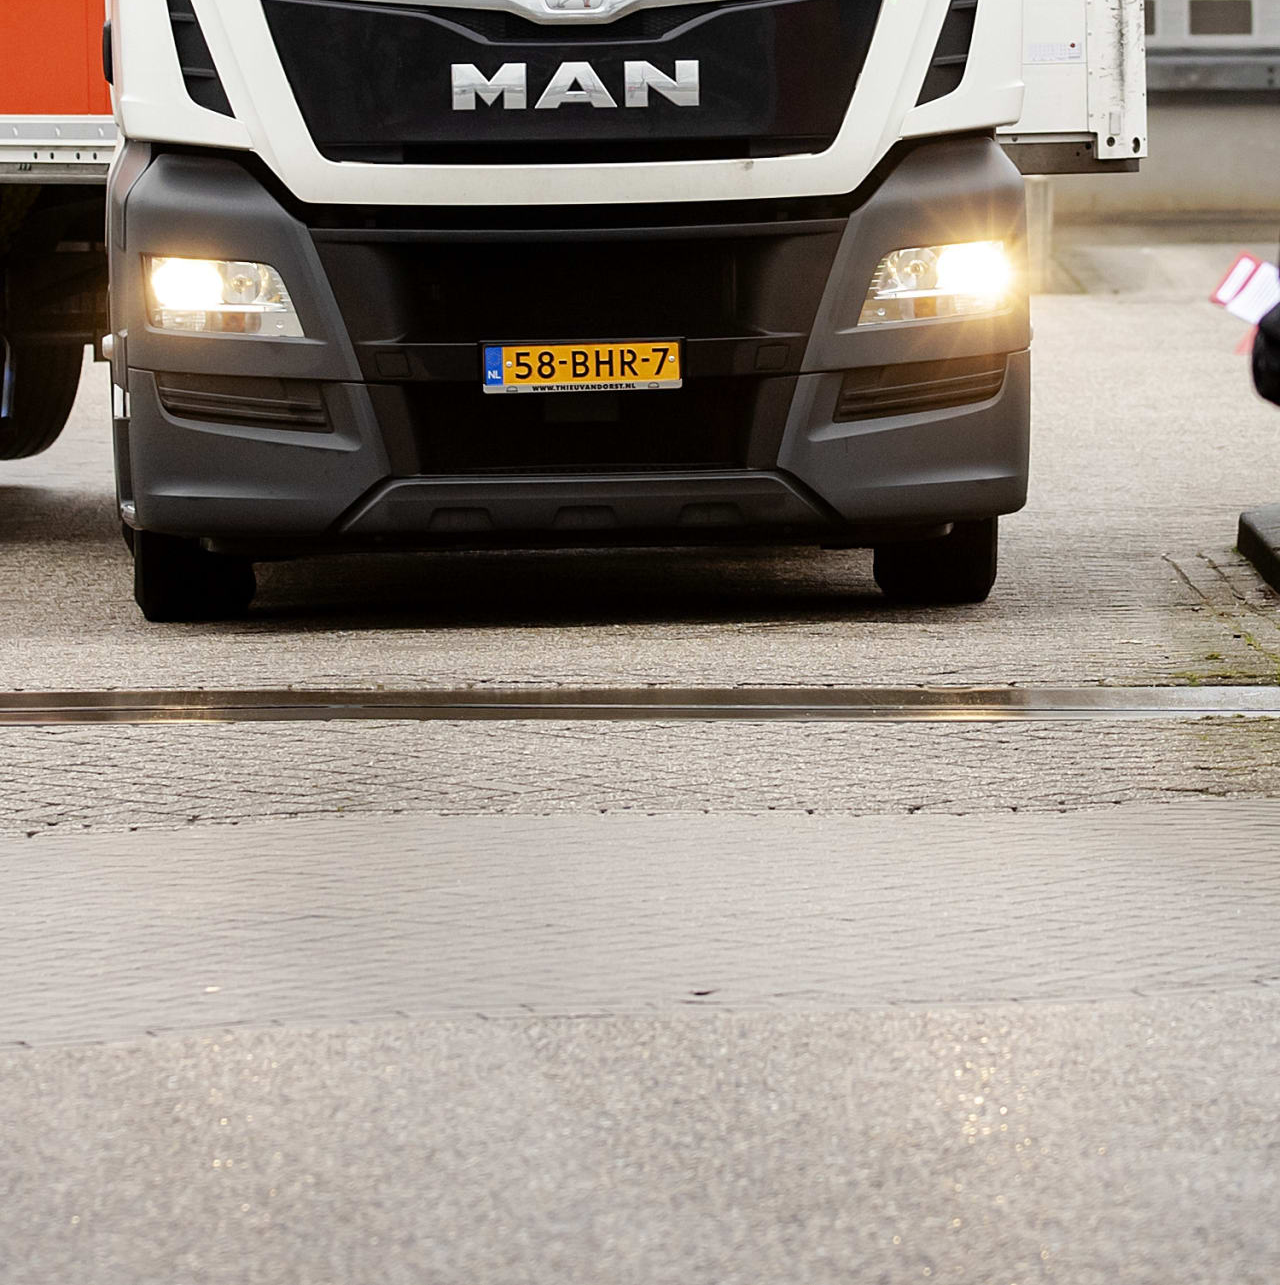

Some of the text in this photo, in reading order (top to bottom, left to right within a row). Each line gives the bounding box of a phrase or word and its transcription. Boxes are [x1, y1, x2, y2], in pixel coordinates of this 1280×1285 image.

[450, 58, 701, 111] MAN
[487, 370, 502, 380] NL
[515, 347, 671, 380] 58-BHR-7
